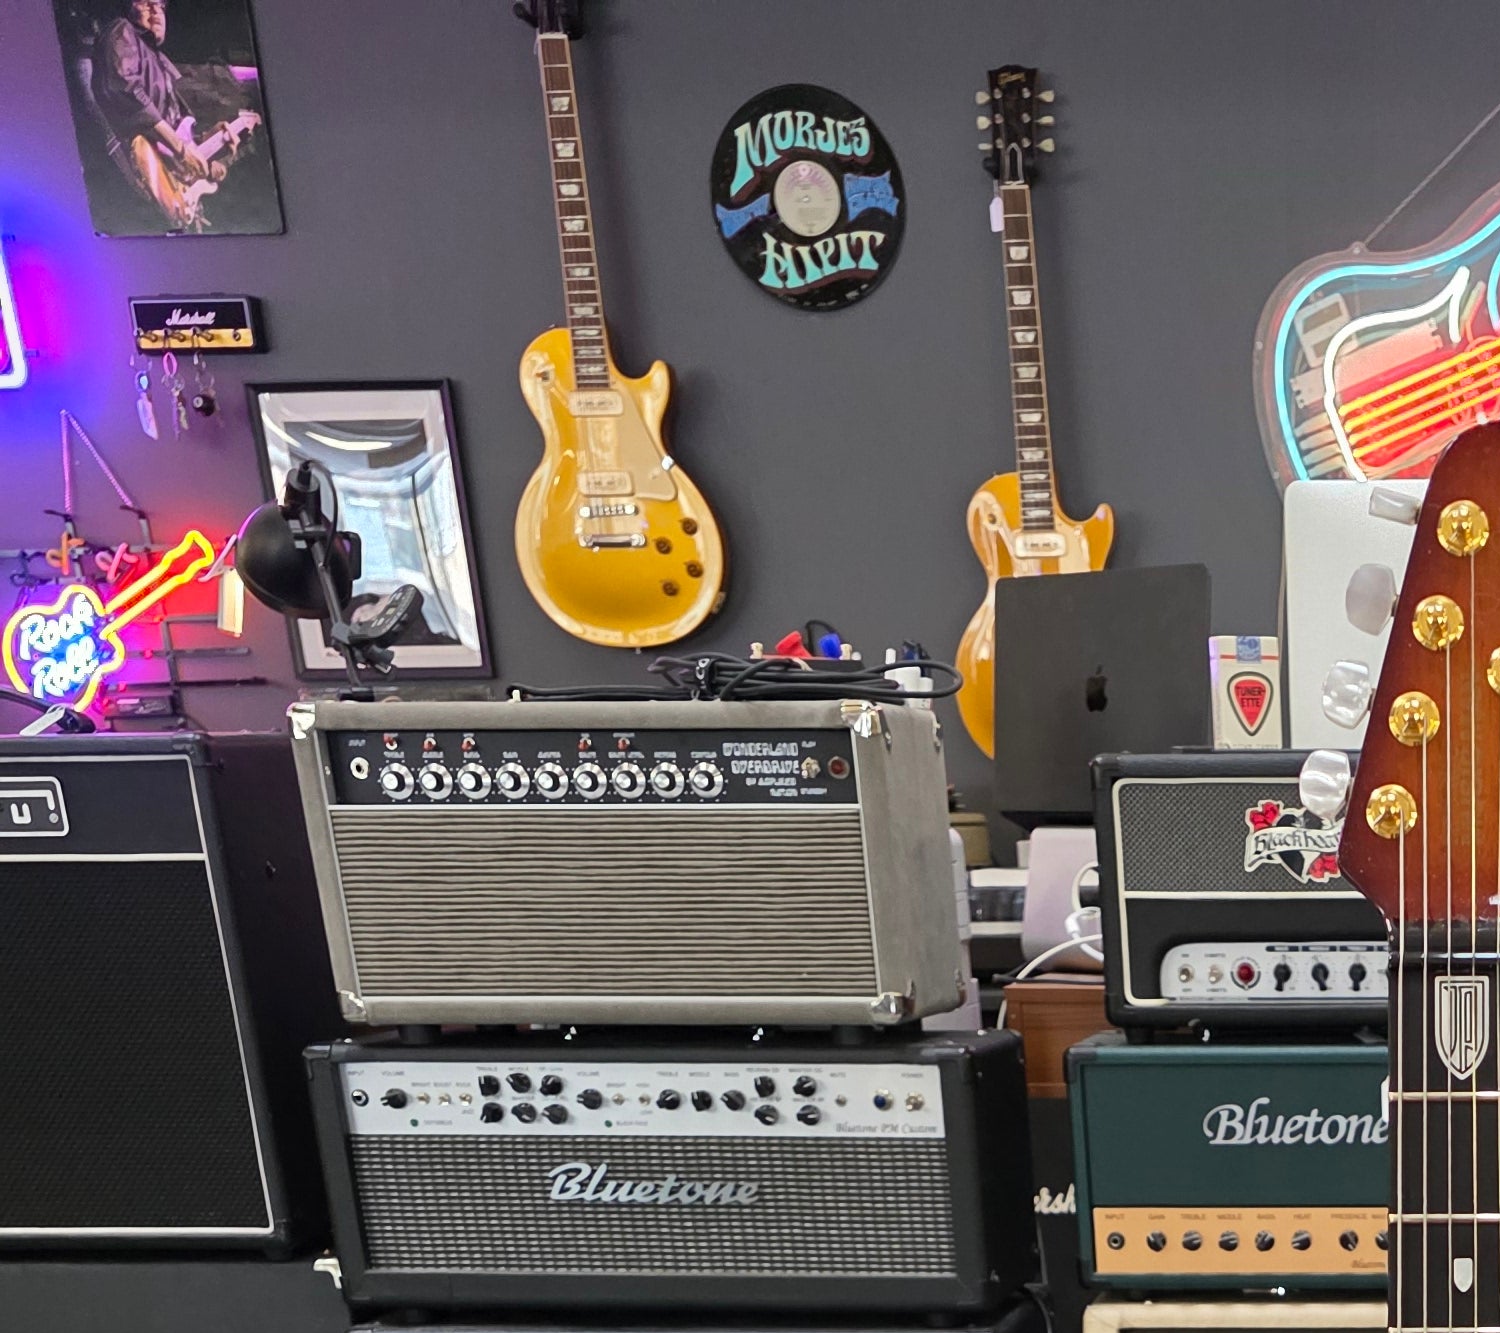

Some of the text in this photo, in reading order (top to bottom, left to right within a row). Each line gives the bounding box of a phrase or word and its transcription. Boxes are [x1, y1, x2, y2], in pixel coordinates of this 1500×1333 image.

[730, 110, 871, 198] MORJES
[759, 231, 886, 289] HIPIT
[165, 308, 216, 326] Marshall
[722, 742, 799, 756] WONDERLAND
[730, 760, 800, 774] OVERDRIVE
[1203, 1097, 1389, 1144] Bluetone
[548, 1162, 759, 1205] Bluetone
